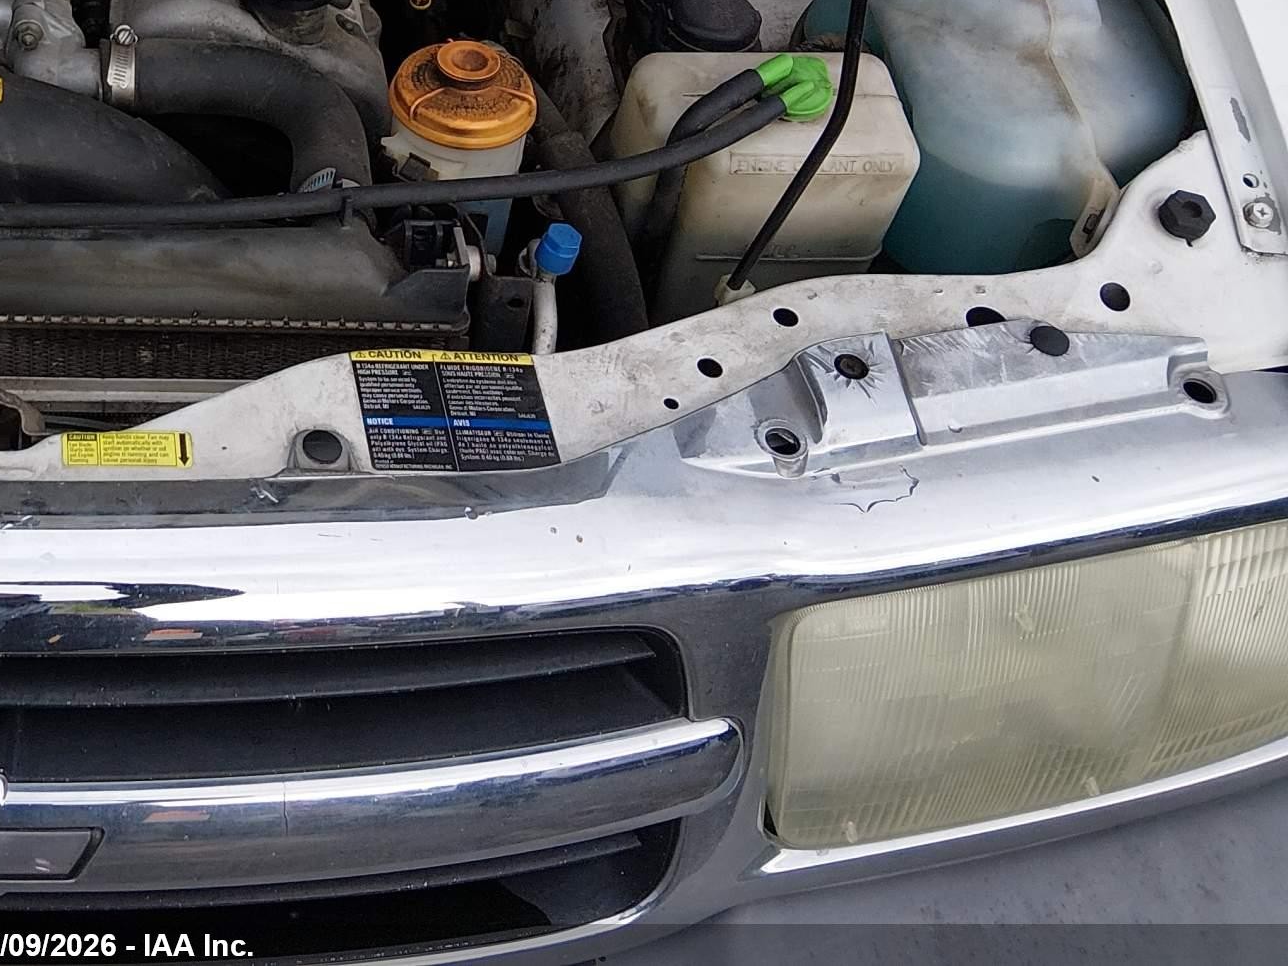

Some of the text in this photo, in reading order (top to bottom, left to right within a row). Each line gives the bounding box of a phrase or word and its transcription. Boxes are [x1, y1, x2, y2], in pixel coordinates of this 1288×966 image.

[737, 160, 785, 173] ENGINE
[863, 160, 897, 173] ONLY
[368, 351, 421, 359] CAUTION
[453, 353, 519, 362] ATTENTION
